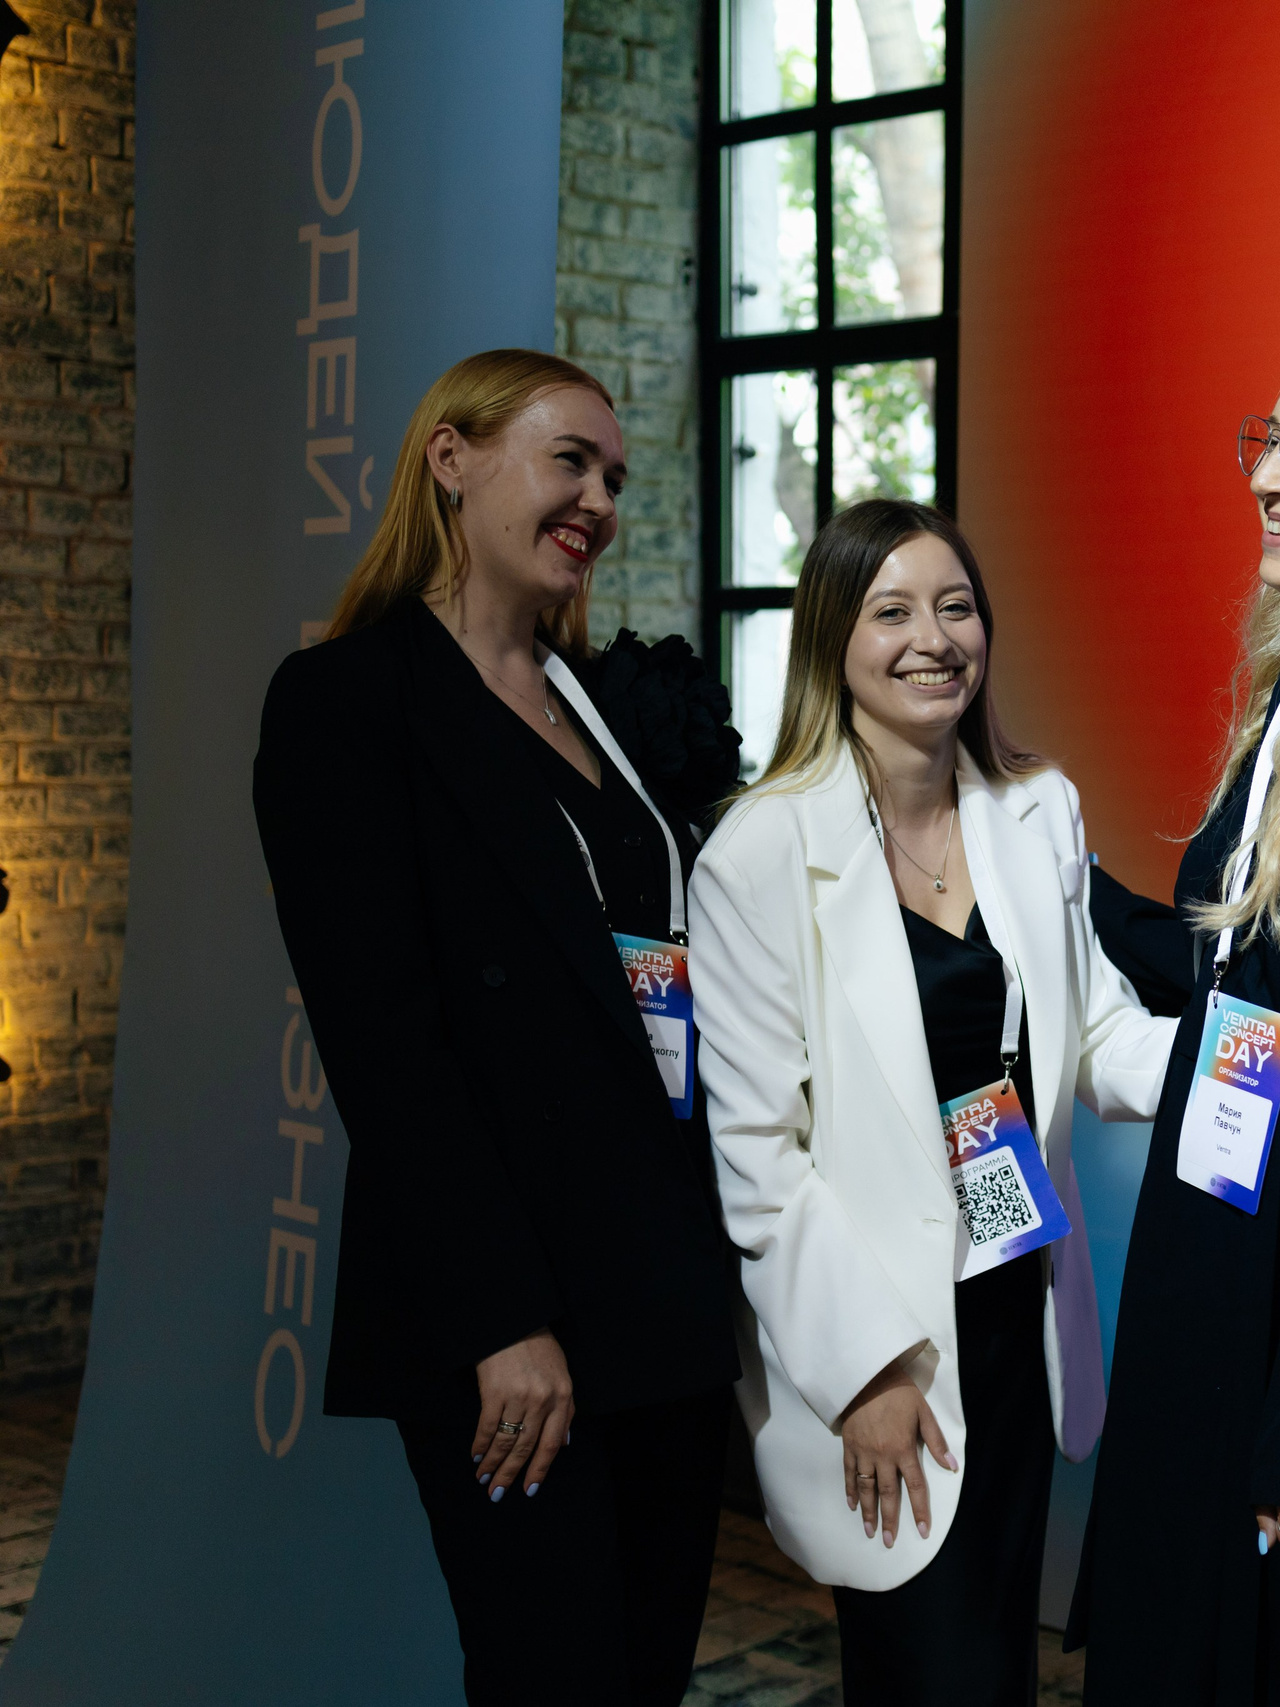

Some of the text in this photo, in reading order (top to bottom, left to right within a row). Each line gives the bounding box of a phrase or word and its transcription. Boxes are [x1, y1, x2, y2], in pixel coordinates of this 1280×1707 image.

[625, 970, 674, 998] AY
[1219, 1023, 1276, 1050] CONCEPT
[1221, 1008, 1276, 1040] VENTRA
[1214, 1033, 1274, 1074] DAY
[1218, 1066, 1260, 1088] ОРГАНИЗАТОР
[941, 1097, 996, 1128] NTRA
[1217, 1101, 1243, 1120] Мария
[1213, 1116, 1242, 1136] Павчун
